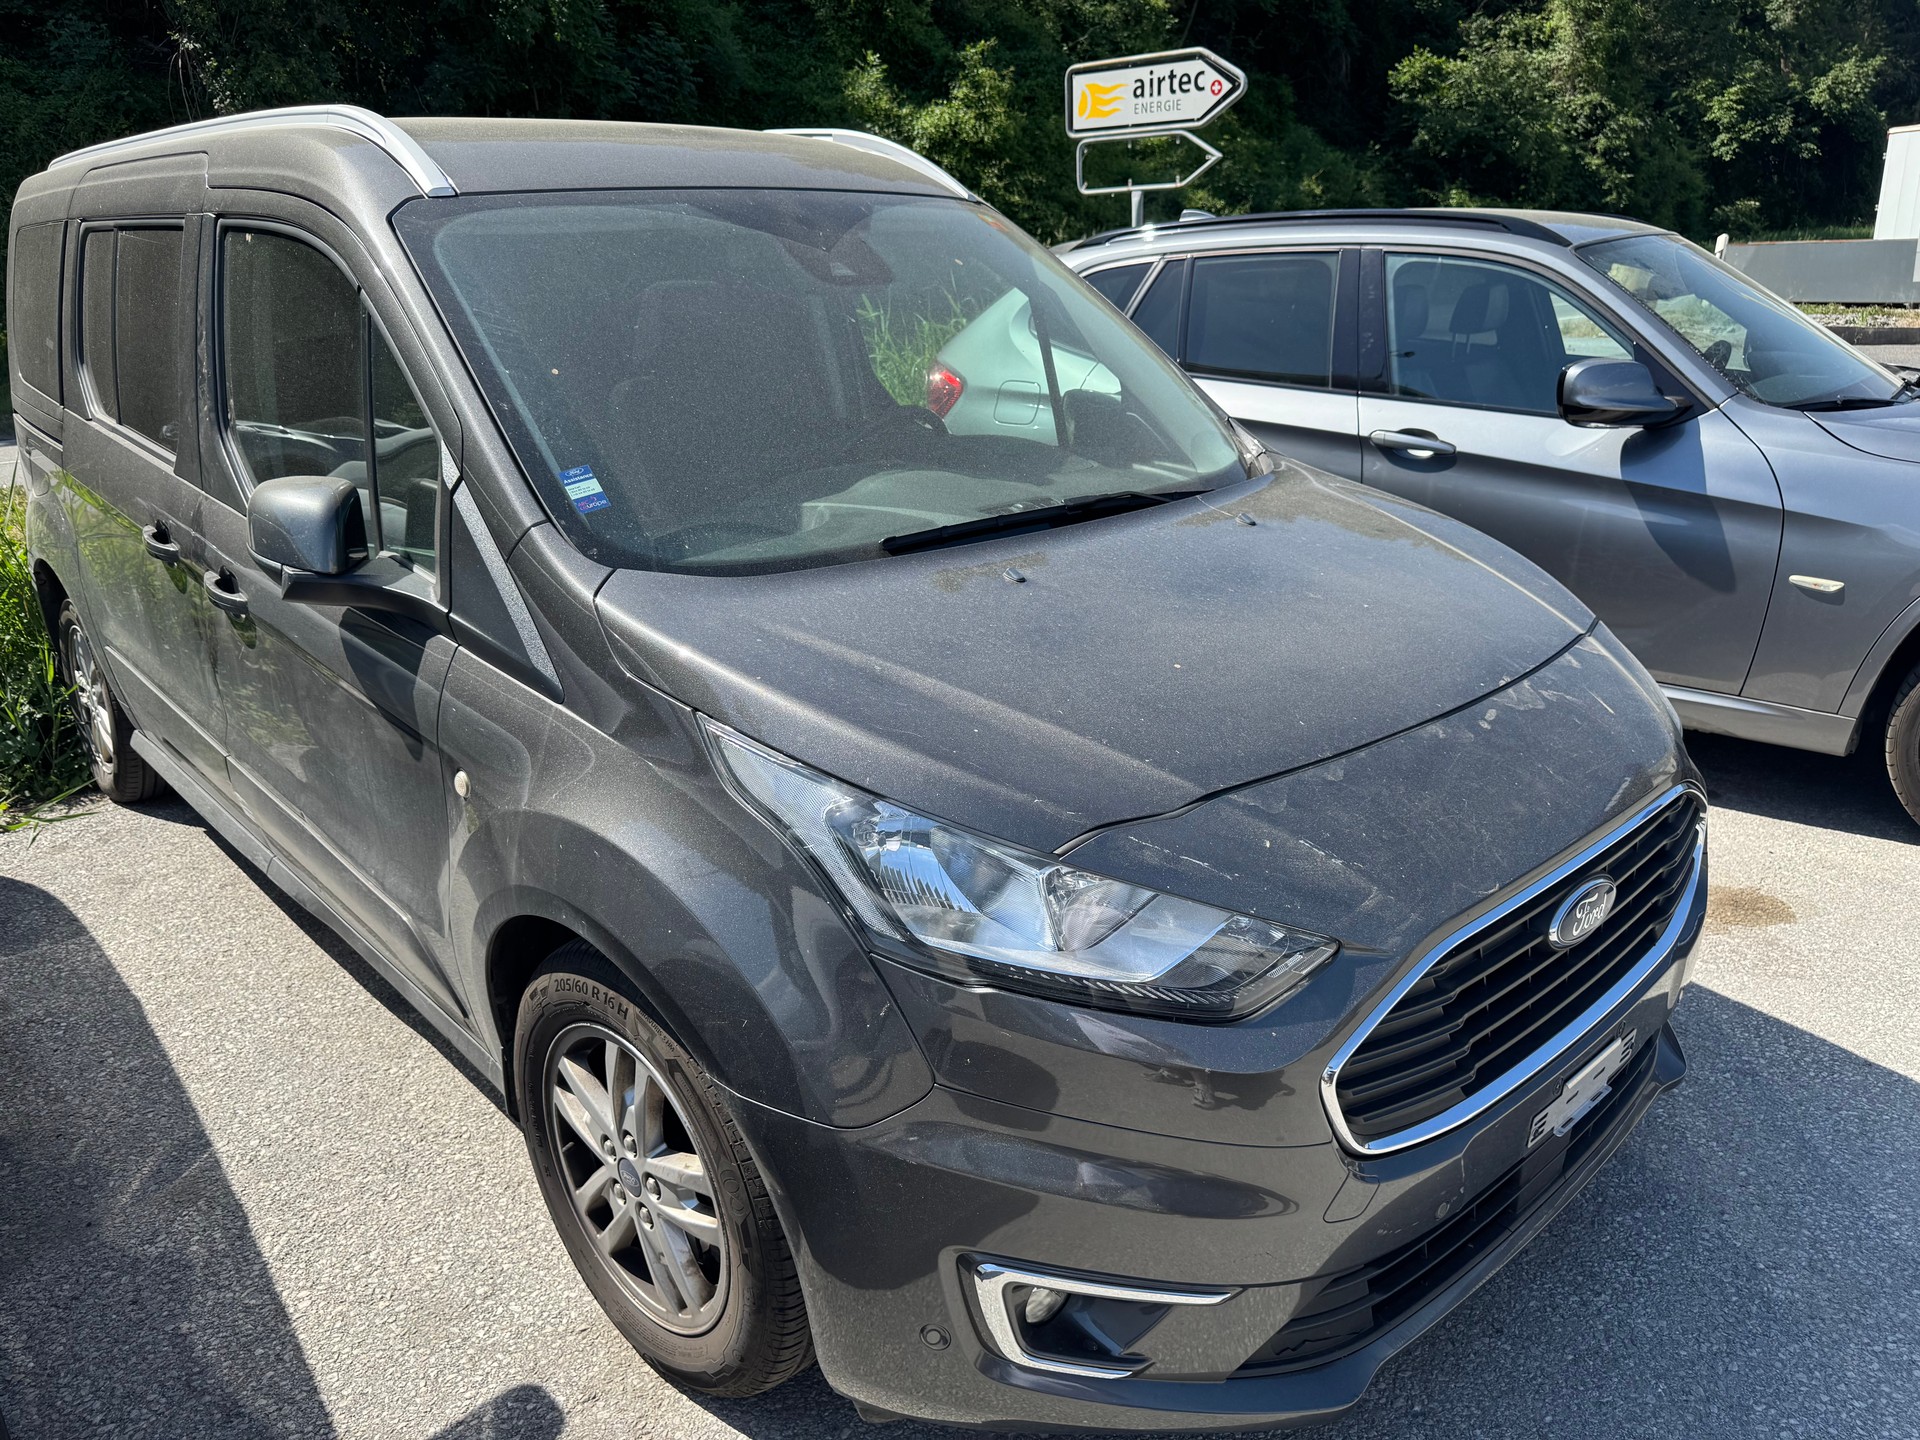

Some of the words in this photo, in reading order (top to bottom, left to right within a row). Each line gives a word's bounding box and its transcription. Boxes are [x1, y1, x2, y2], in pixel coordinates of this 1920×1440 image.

[1133, 69, 1206, 99] airtec
[1134, 99, 1182, 115] ENERGIE
[563, 473, 593, 484] Assistance
[1572, 892, 1607, 936] Ford
[554, 978, 588, 995] 205/60
[591, 985, 601, 1003] R
[602, 991, 616, 1010] 16
[617, 1002, 629, 1021] H
